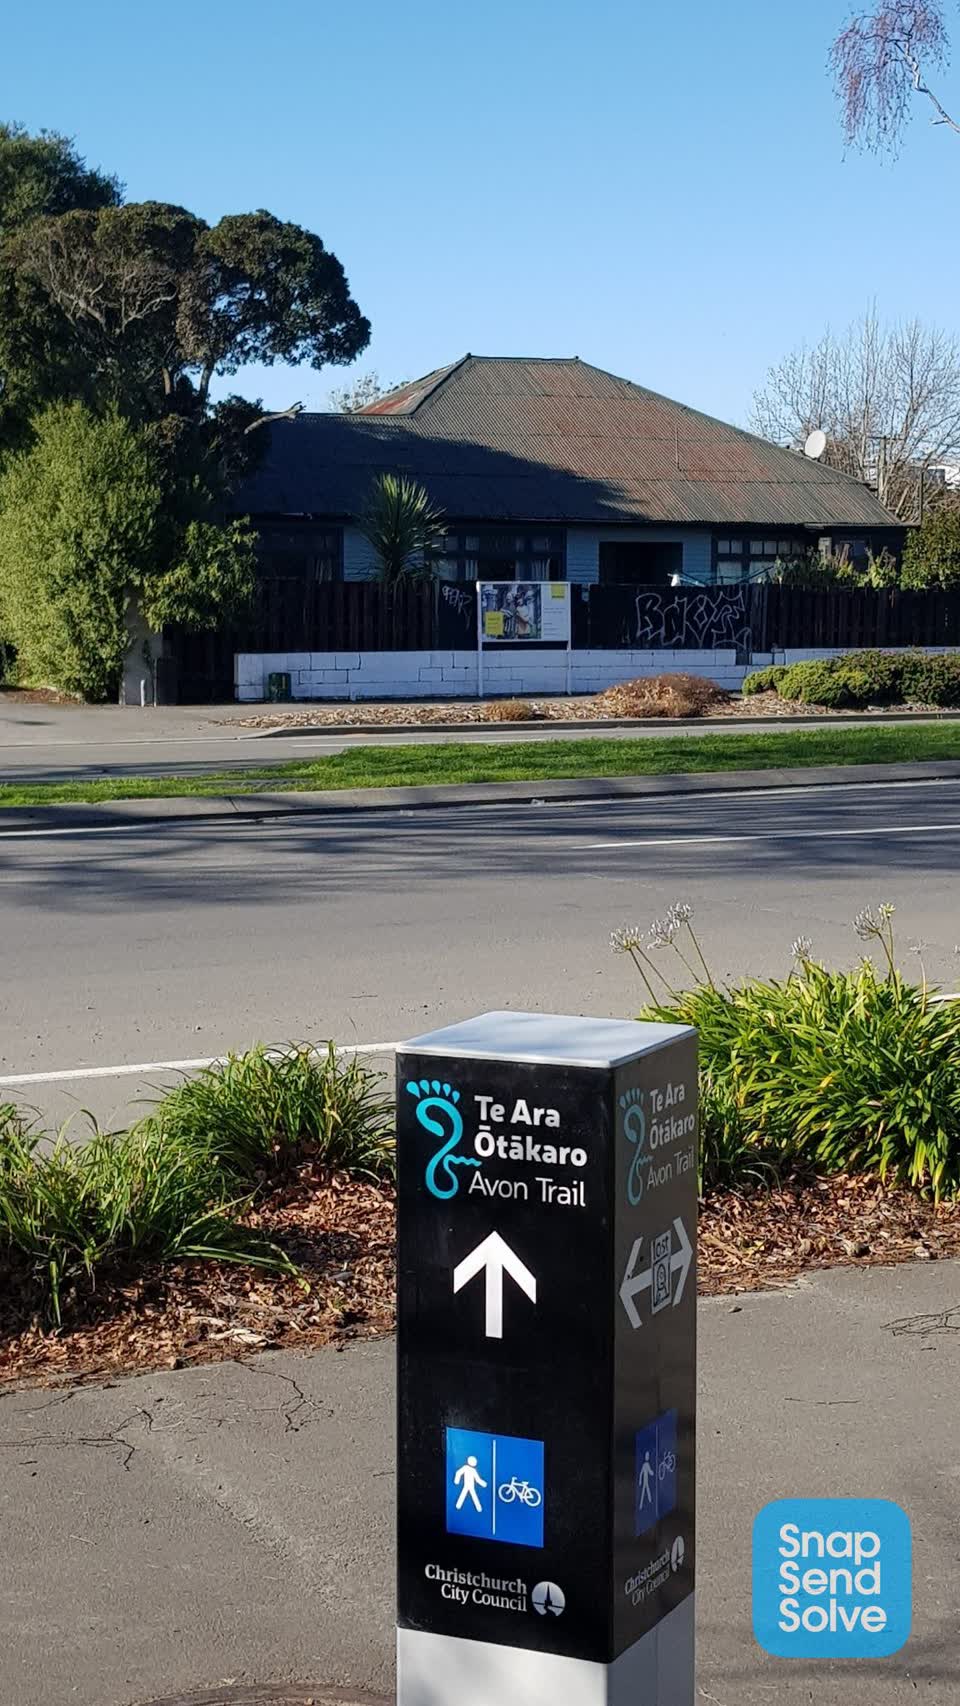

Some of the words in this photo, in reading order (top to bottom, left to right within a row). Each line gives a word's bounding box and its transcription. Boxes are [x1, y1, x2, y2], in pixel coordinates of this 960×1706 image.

[474, 1095, 506, 1122] Te
[510, 1099, 560, 1128] Ara
[649, 1088, 663, 1114] Te
[664, 1082, 685, 1108] Ara
[474, 1125, 588, 1167] Ōtākaro
[647, 1164, 673, 1191] Avon
[673, 1145, 694, 1176] Trail
[468, 1170, 528, 1200] Avon
[535, 1177, 586, 1207] Trail
[424, 1564, 527, 1595] Christchurch
[440, 1584, 469, 1605] City
[472, 1589, 527, 1612] Council
